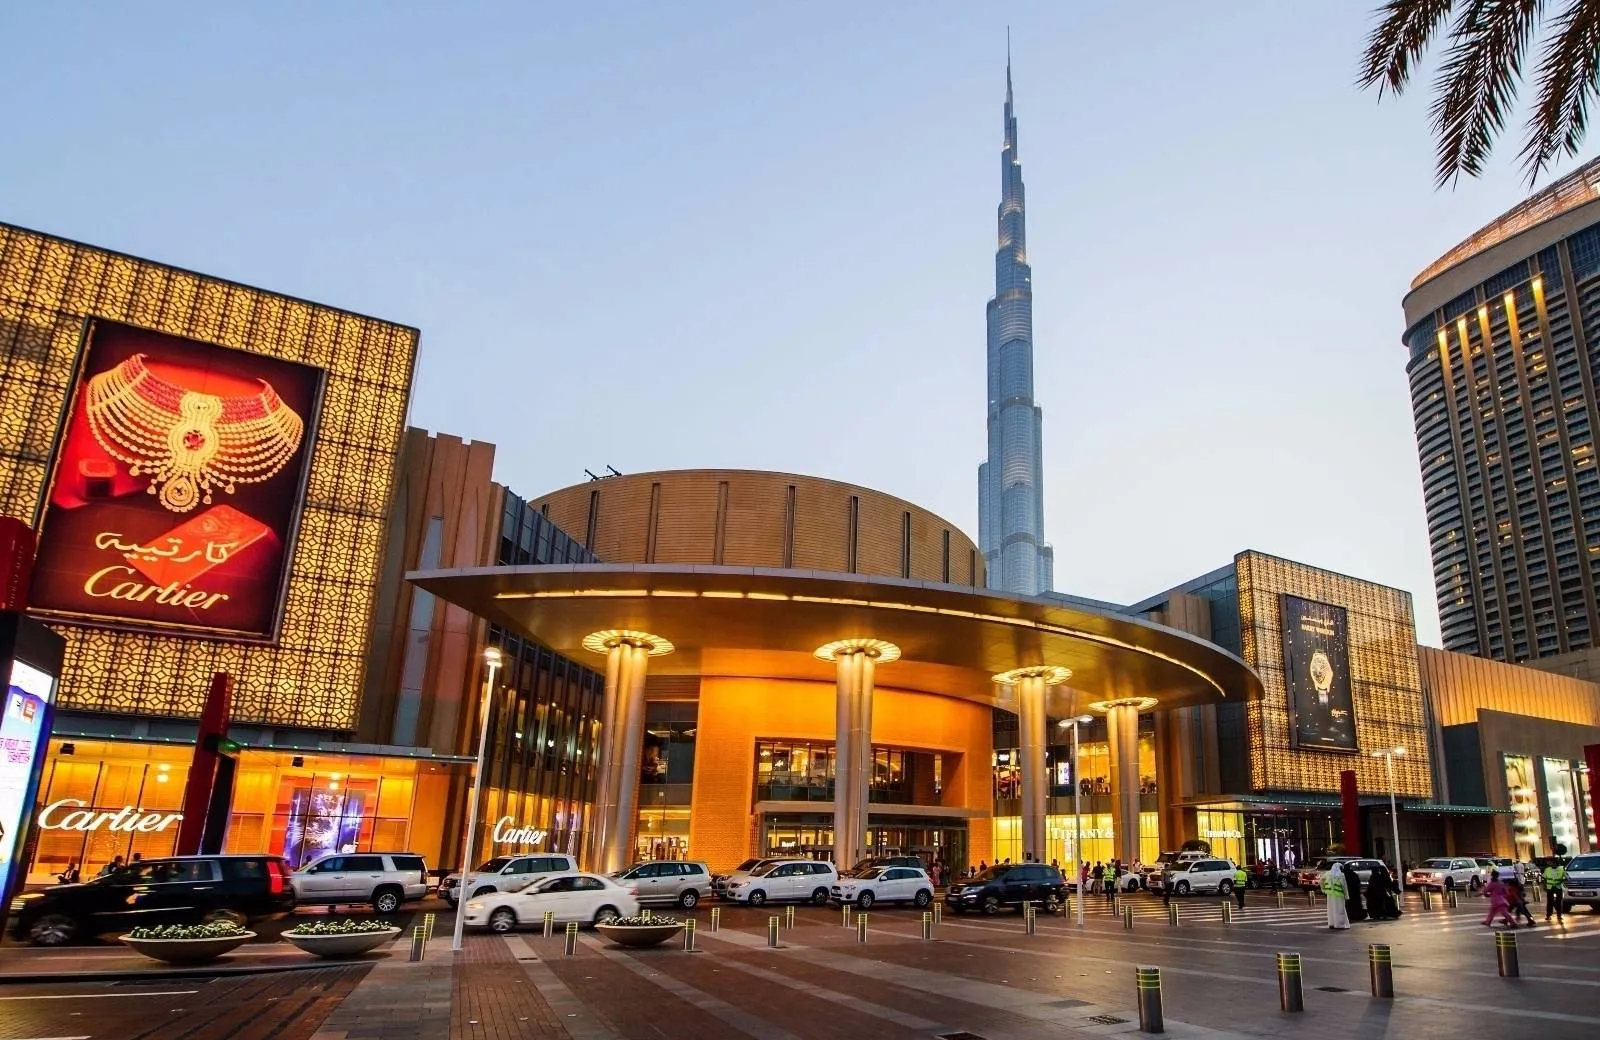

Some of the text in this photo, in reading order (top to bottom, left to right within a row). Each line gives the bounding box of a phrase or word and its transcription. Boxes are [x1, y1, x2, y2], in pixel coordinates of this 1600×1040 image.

[84, 565, 229, 609] Cartier
[38, 798, 184, 832] Cartier
[493, 815, 547, 845] Cartier
